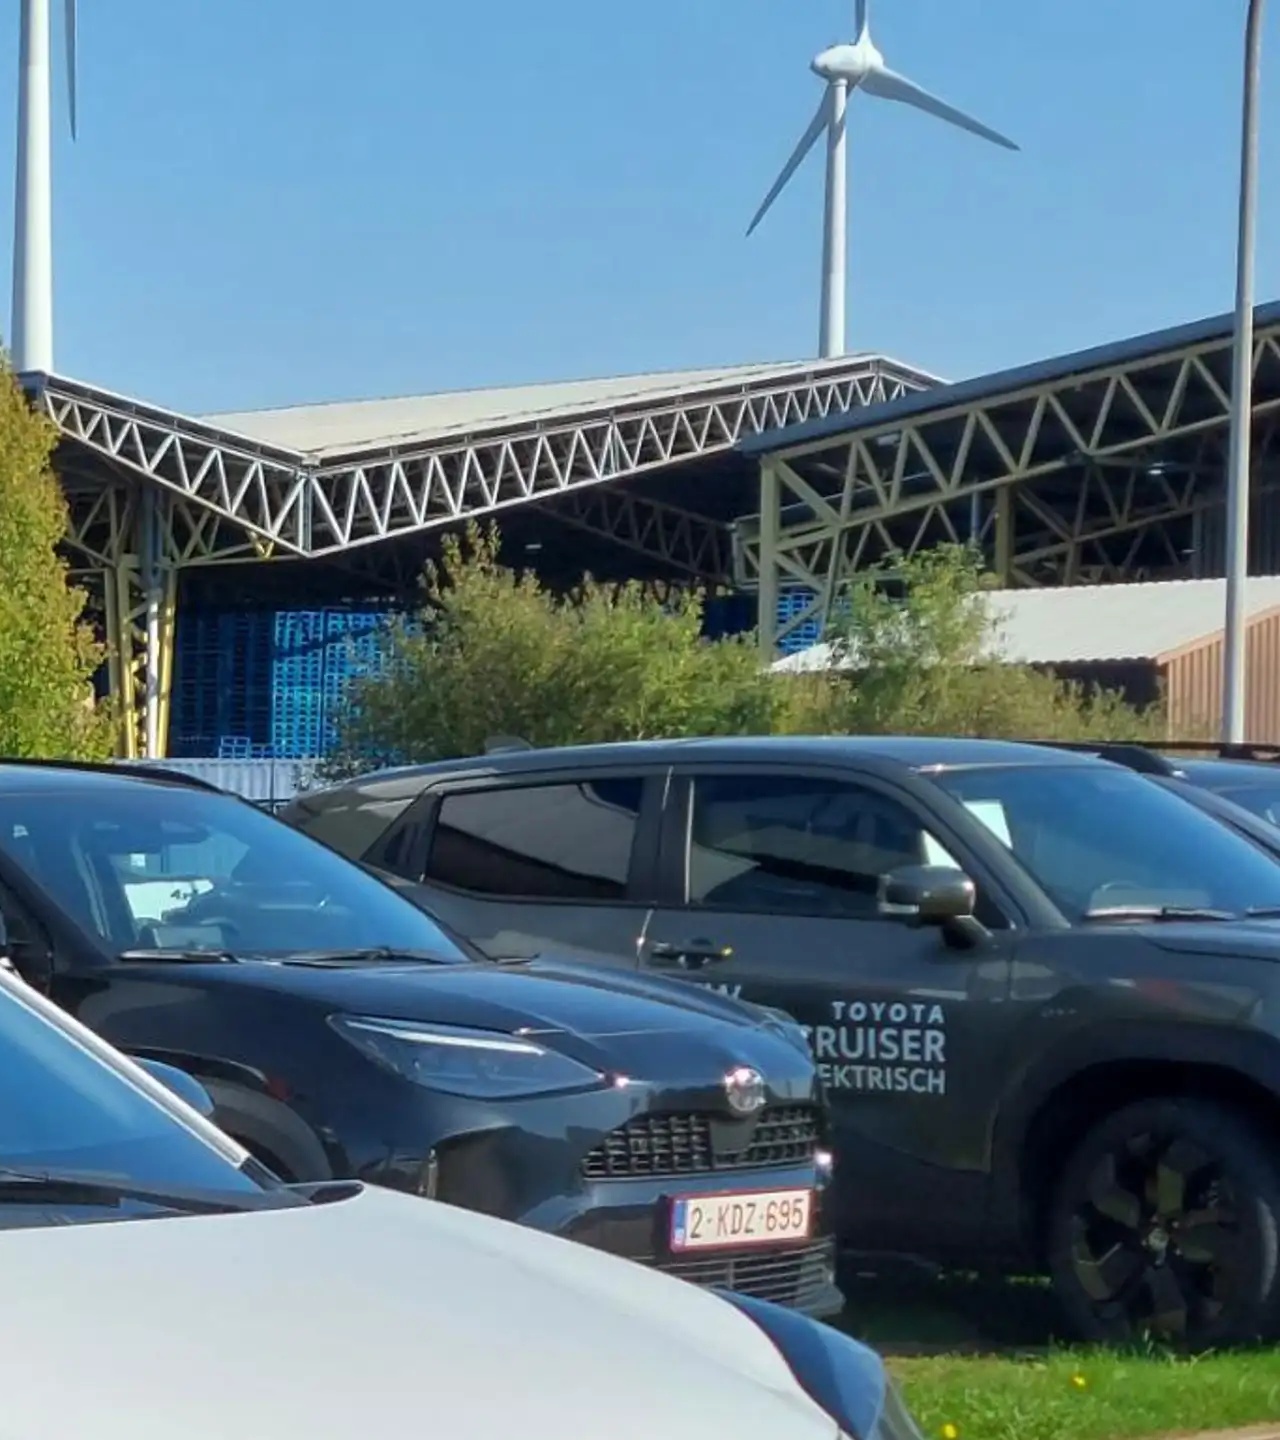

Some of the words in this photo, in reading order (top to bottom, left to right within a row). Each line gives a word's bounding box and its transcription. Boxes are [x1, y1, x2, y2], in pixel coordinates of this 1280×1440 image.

[832, 1001, 945, 1024] TOYOTA
[817, 1063, 946, 1094] EKTRISCH
[690, 1198, 804, 1239] 2-KDZ-695
